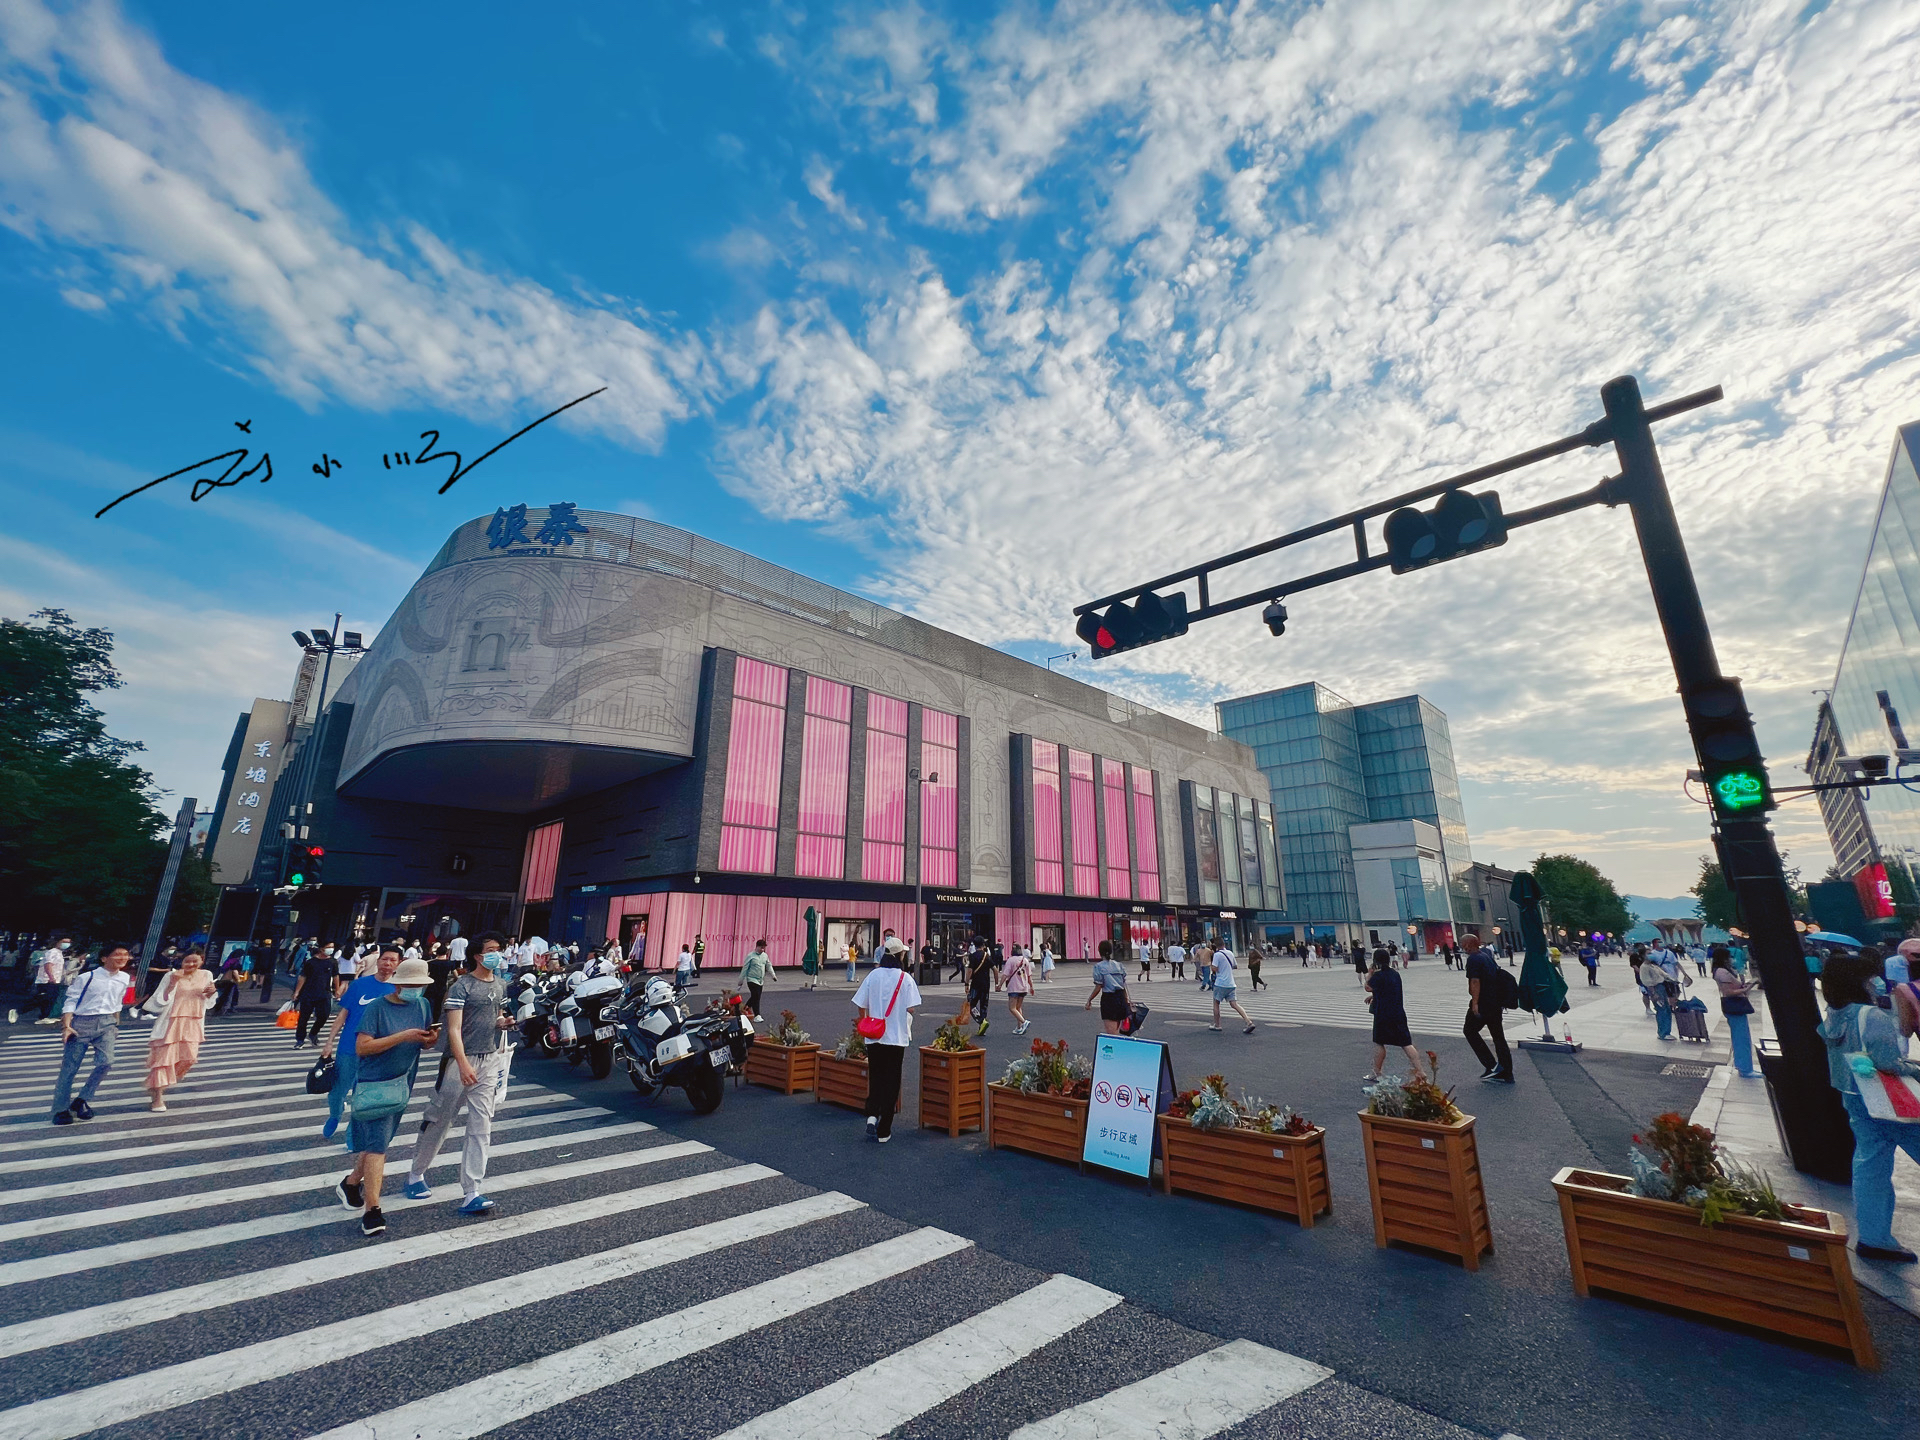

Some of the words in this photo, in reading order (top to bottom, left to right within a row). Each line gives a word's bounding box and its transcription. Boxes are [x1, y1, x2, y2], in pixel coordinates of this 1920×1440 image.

[485, 501, 590, 549] 银泰
[231, 740, 272, 835] 东坡酒店
[1099, 1127, 1138, 1146] 步行区域
